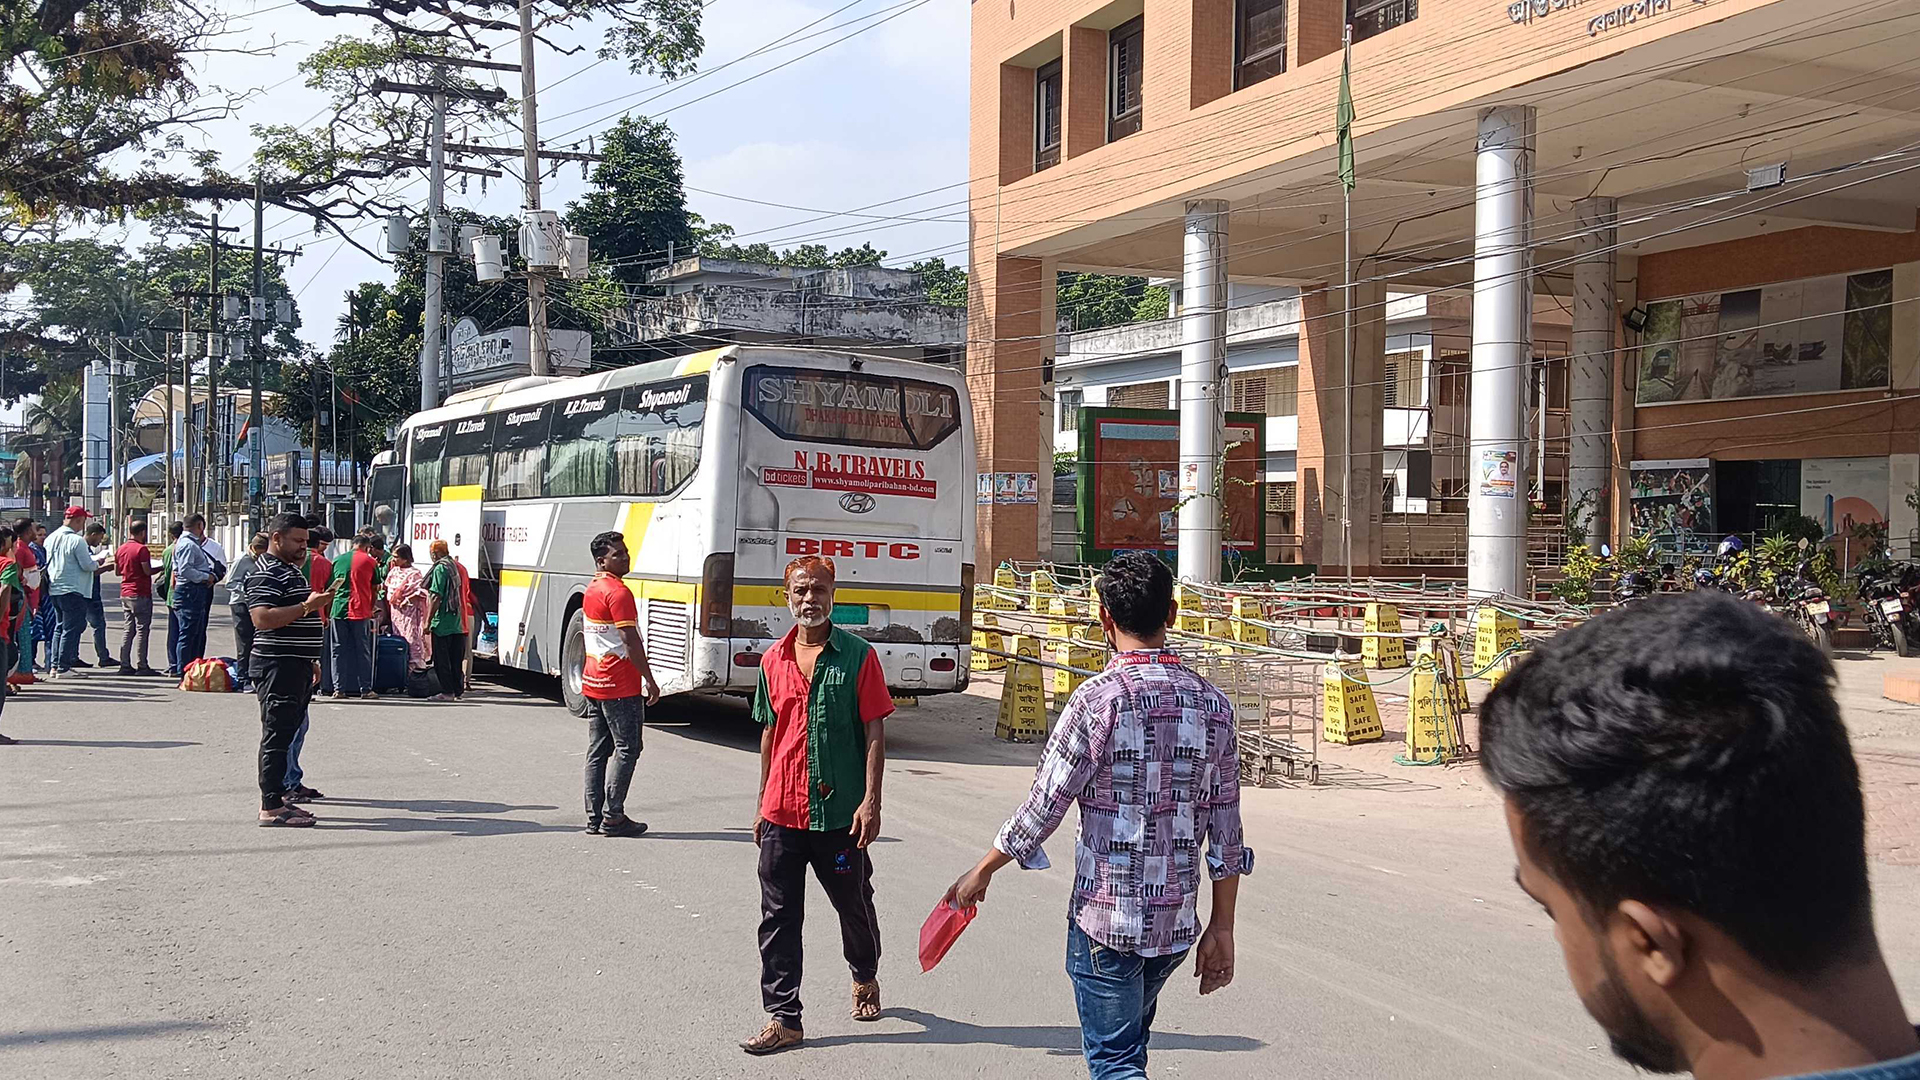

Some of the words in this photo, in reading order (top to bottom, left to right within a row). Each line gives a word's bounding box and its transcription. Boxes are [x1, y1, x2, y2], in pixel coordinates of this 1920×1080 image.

[638, 383, 692, 411] Shyamoli
[414, 523, 440, 540] BRTC
[786, 537, 920, 560] BRTC
[1345, 683, 1367, 693] BUILD
[1019, 694, 1038, 705] আইন
[1349, 693, 1367, 704] SAFE
[1355, 705, 1366, 714] BE
[1020, 717, 1036, 727] চলুন
[1353, 715, 1371, 726] SAFE
